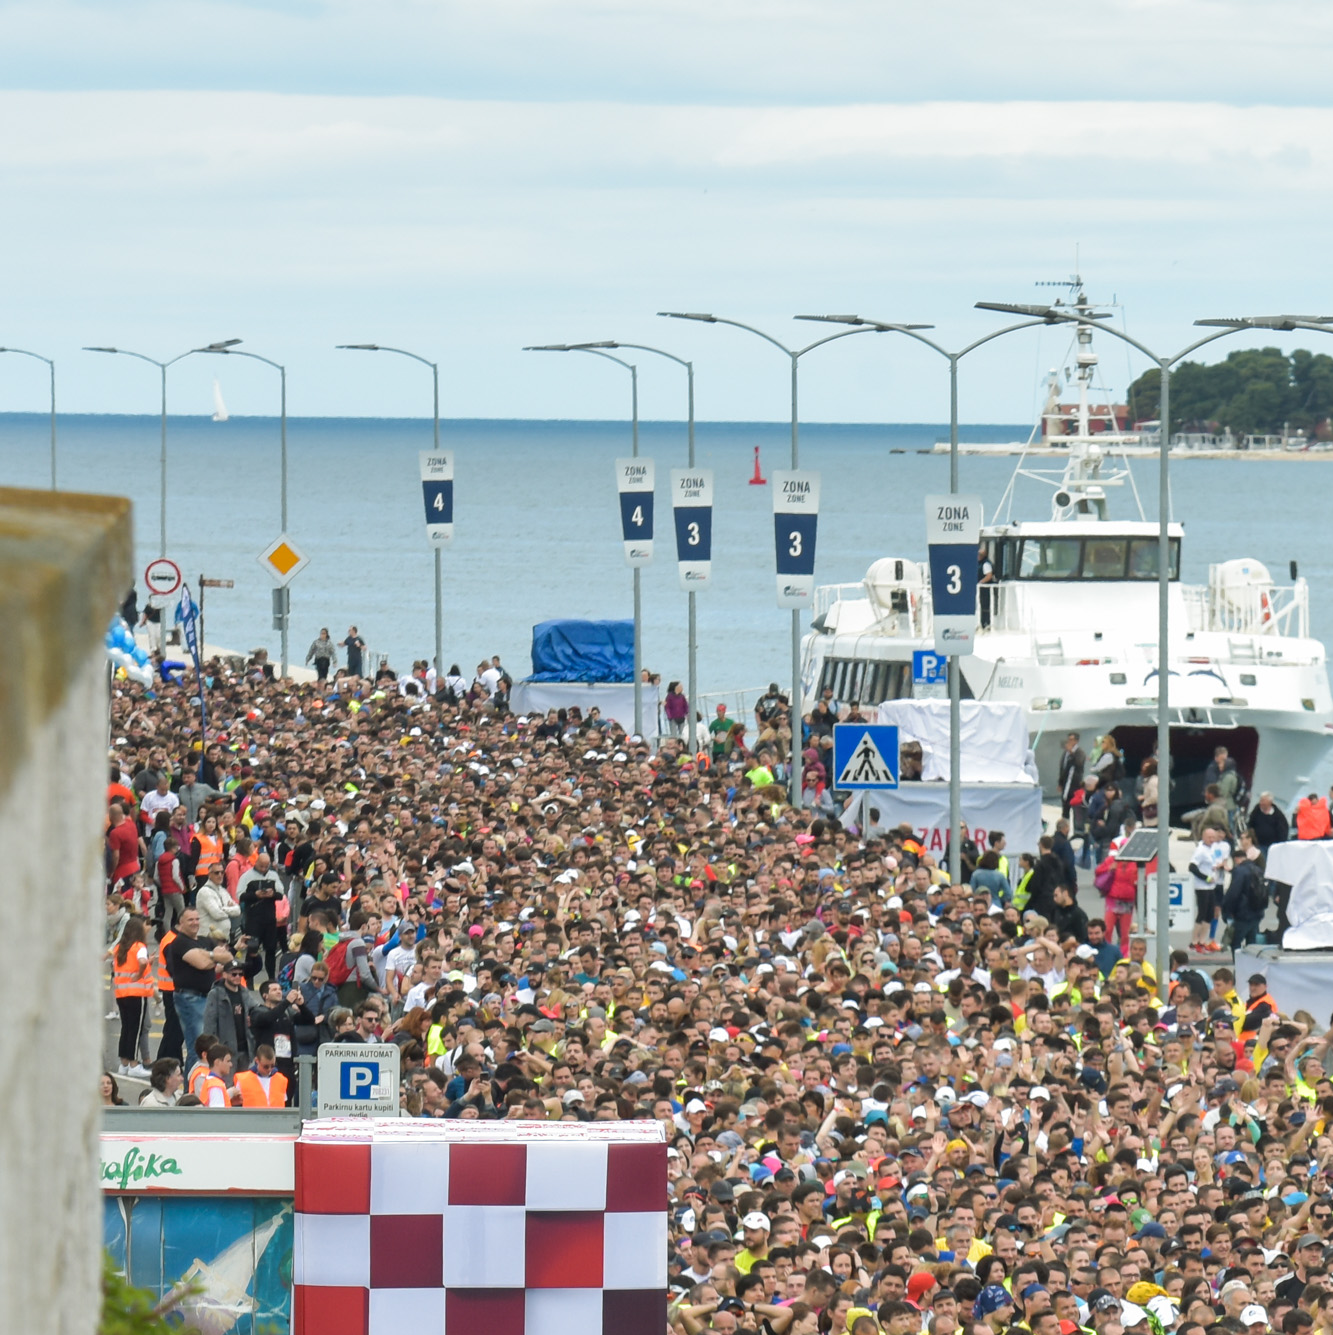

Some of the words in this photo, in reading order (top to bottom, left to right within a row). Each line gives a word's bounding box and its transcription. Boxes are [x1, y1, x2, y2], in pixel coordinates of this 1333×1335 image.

[625, 466, 647, 476] ZONA
[680, 478, 705, 489] ZONA
[782, 481, 810, 494] ZONA
[433, 492, 445, 512] 4
[632, 505, 644, 527] 4
[937, 506, 969, 520] ZONA
[688, 522, 700, 546] 3
[942, 522, 964, 532] ZONE
[788, 531, 802, 557] 3
[946, 564, 962, 594] 3
[324, 1050, 360, 1058] PARKIRNI
[361, 1050, 394, 1058] AUTOMAT
[350, 1067, 372, 1096] P
[324, 1103, 353, 1112] Parkirnu
[355, 1103, 372, 1111] kartu
[374, 1103, 394, 1112] kupiti
